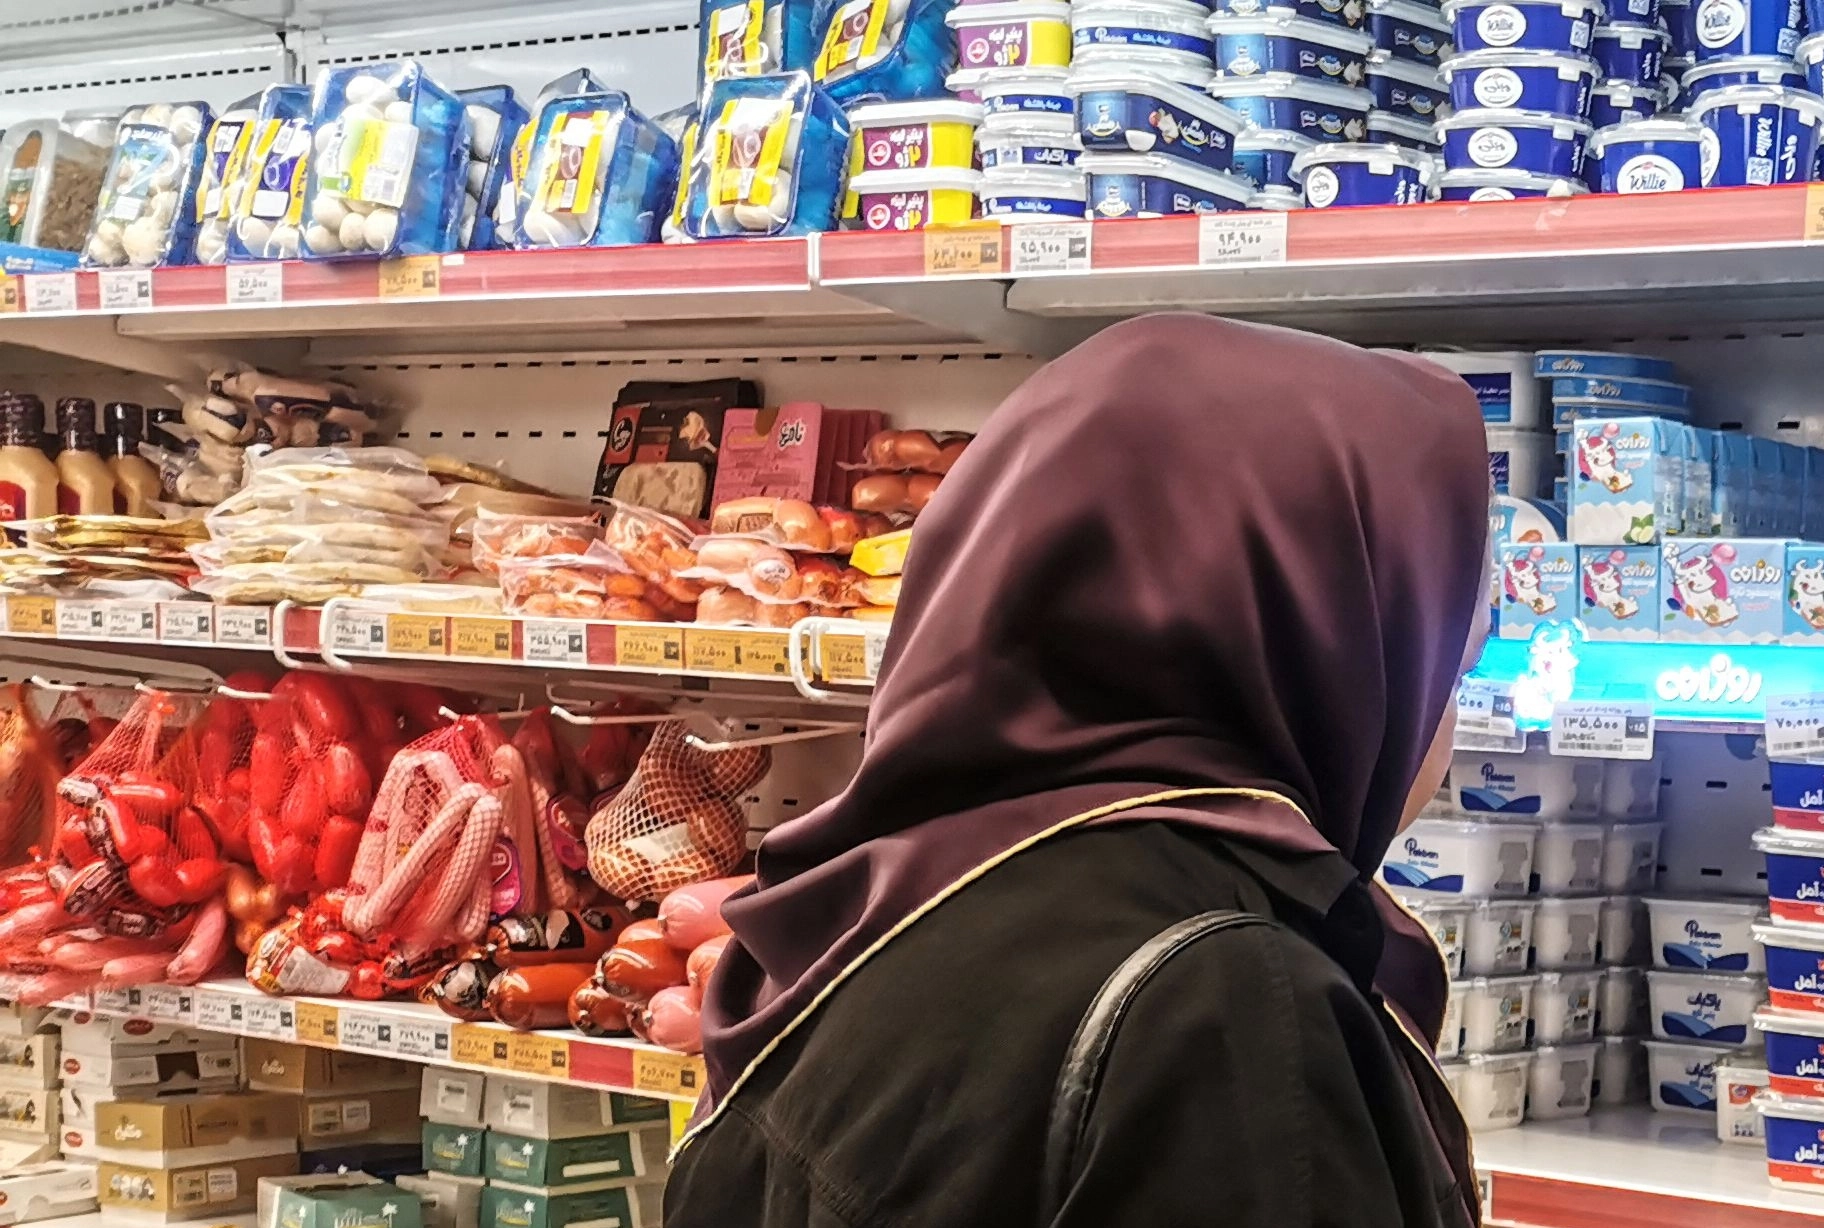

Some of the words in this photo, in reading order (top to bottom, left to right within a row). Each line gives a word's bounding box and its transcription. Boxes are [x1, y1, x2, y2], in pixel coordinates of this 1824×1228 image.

[1630, 174, 1667, 191] Willie
[1730, 558, 1781, 585] روزانه
[1656, 653, 1763, 703] روزانه
